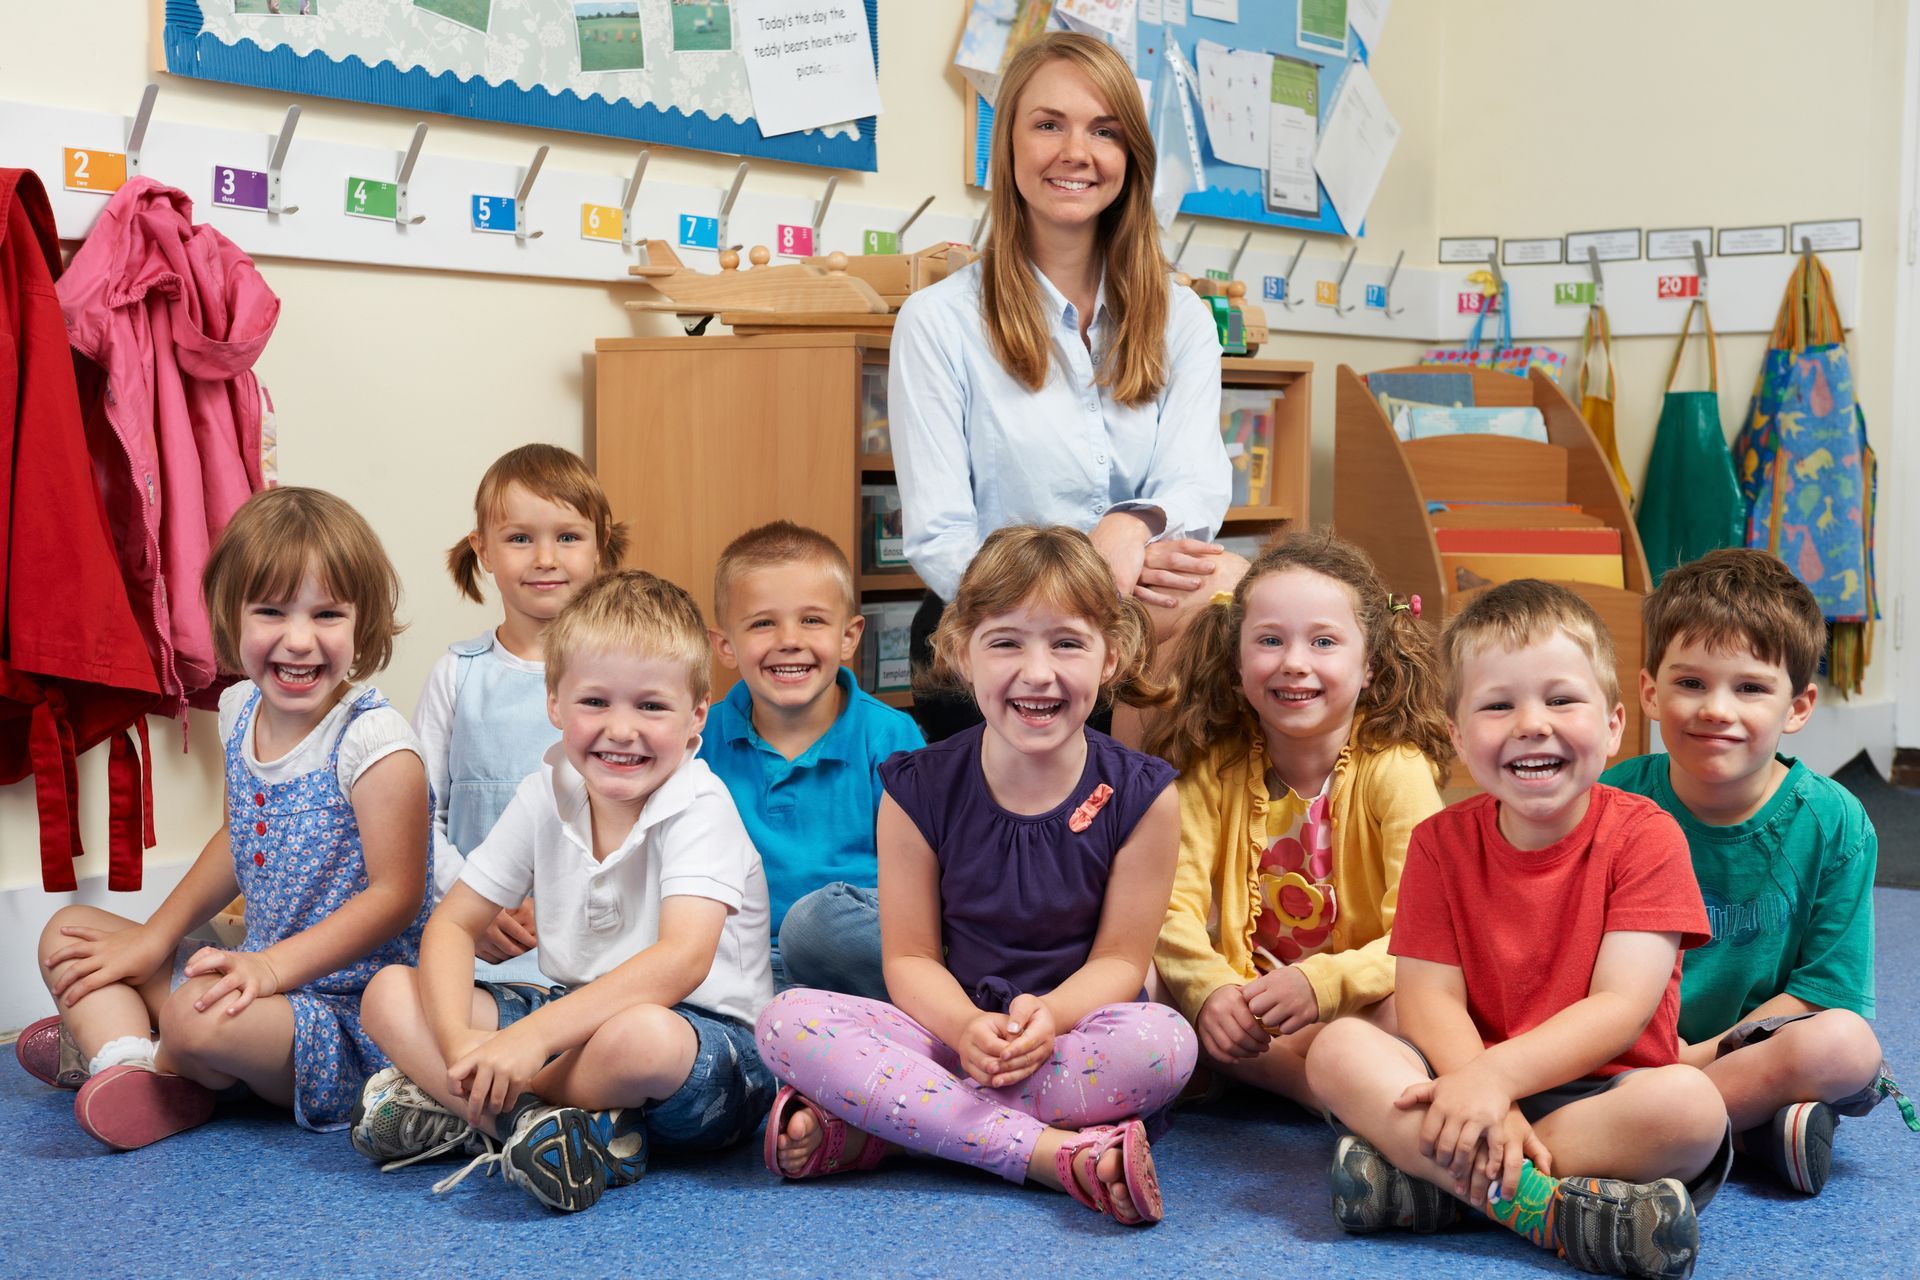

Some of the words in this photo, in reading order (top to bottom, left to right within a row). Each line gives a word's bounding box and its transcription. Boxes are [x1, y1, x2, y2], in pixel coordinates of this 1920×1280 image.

[757, 13, 793, 31] Today's
[795, 11, 810, 24] the
[812, 10, 828, 25] day
[829, 6, 846, 20] the
[754, 42, 781, 58] teddy
[783, 40, 809, 53] bears
[811, 35, 833, 48] have
[834, 29, 858, 44] their
[73, 151, 90, 178] 2
[221, 169, 236, 195] 3
[353, 180, 367, 205] 4
[478, 197, 491, 221] 5
[589, 207, 600, 229] 6
[686, 216, 697, 238] 7
[783, 226, 794, 248] 8
[869, 232, 878, 252] 9
[1265, 277, 1278, 295] 15
[1367, 287, 1379, 301] 17
[1557, 284, 1577, 300] 19
[1659, 276, 1682, 293] 20
[1461, 293, 1479, 309] 18
